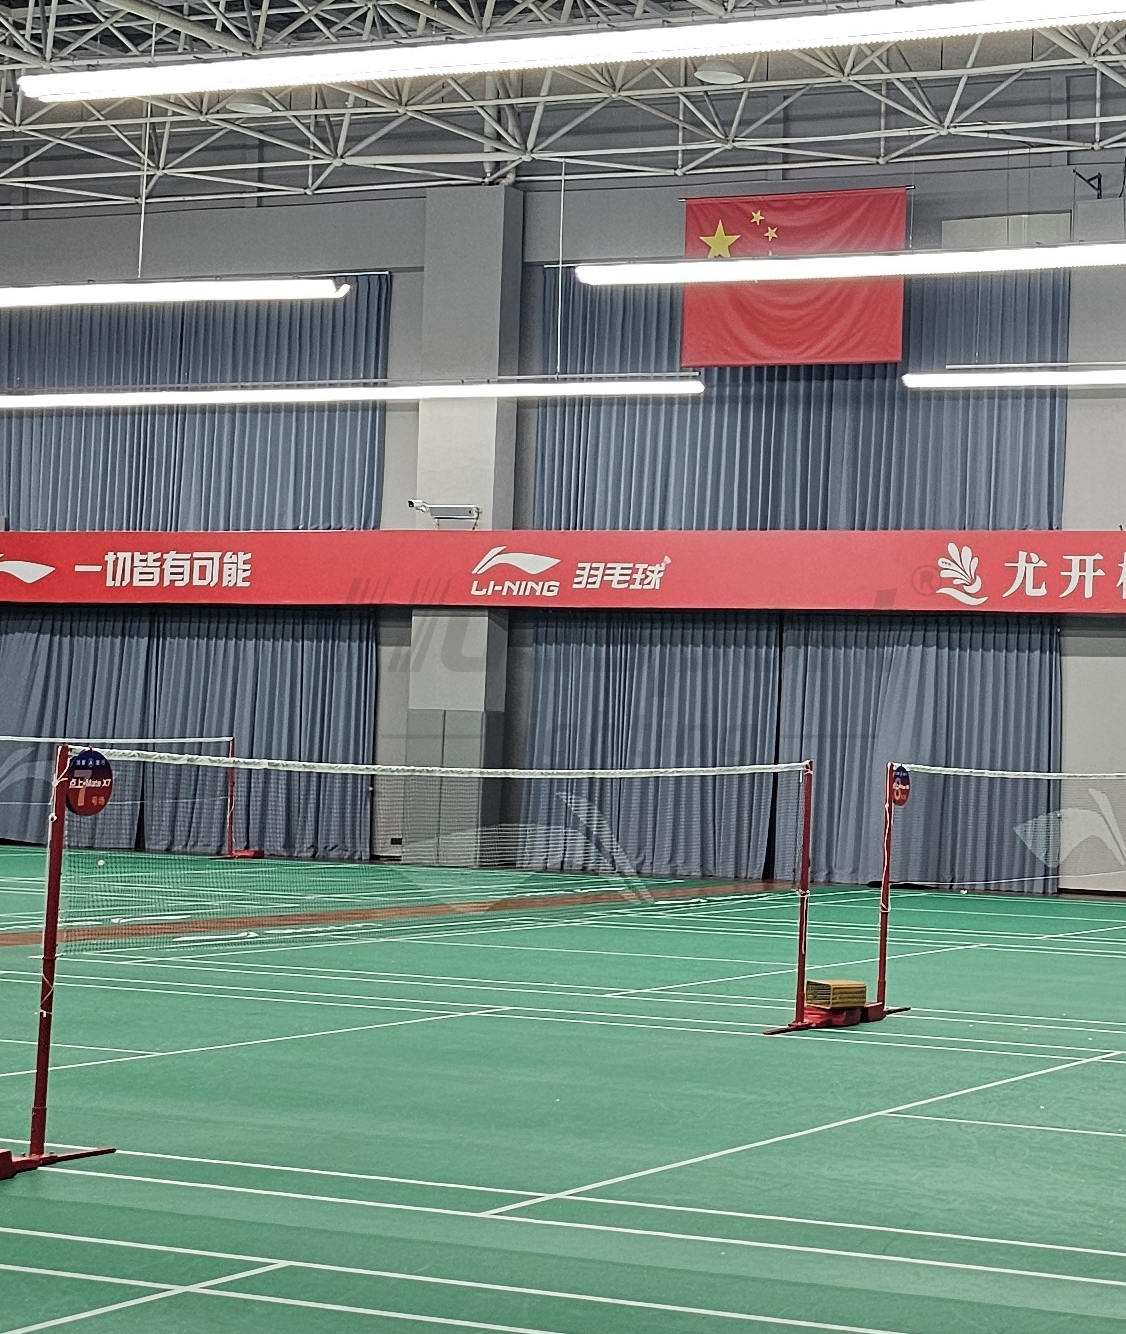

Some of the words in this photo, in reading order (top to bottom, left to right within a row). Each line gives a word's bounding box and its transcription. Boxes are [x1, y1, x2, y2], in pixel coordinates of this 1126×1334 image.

[74, 551, 252, 587] 一切皆有可能
[572, 559, 668, 590] 羽毛球
[470, 580, 560, 597] LI-NING
